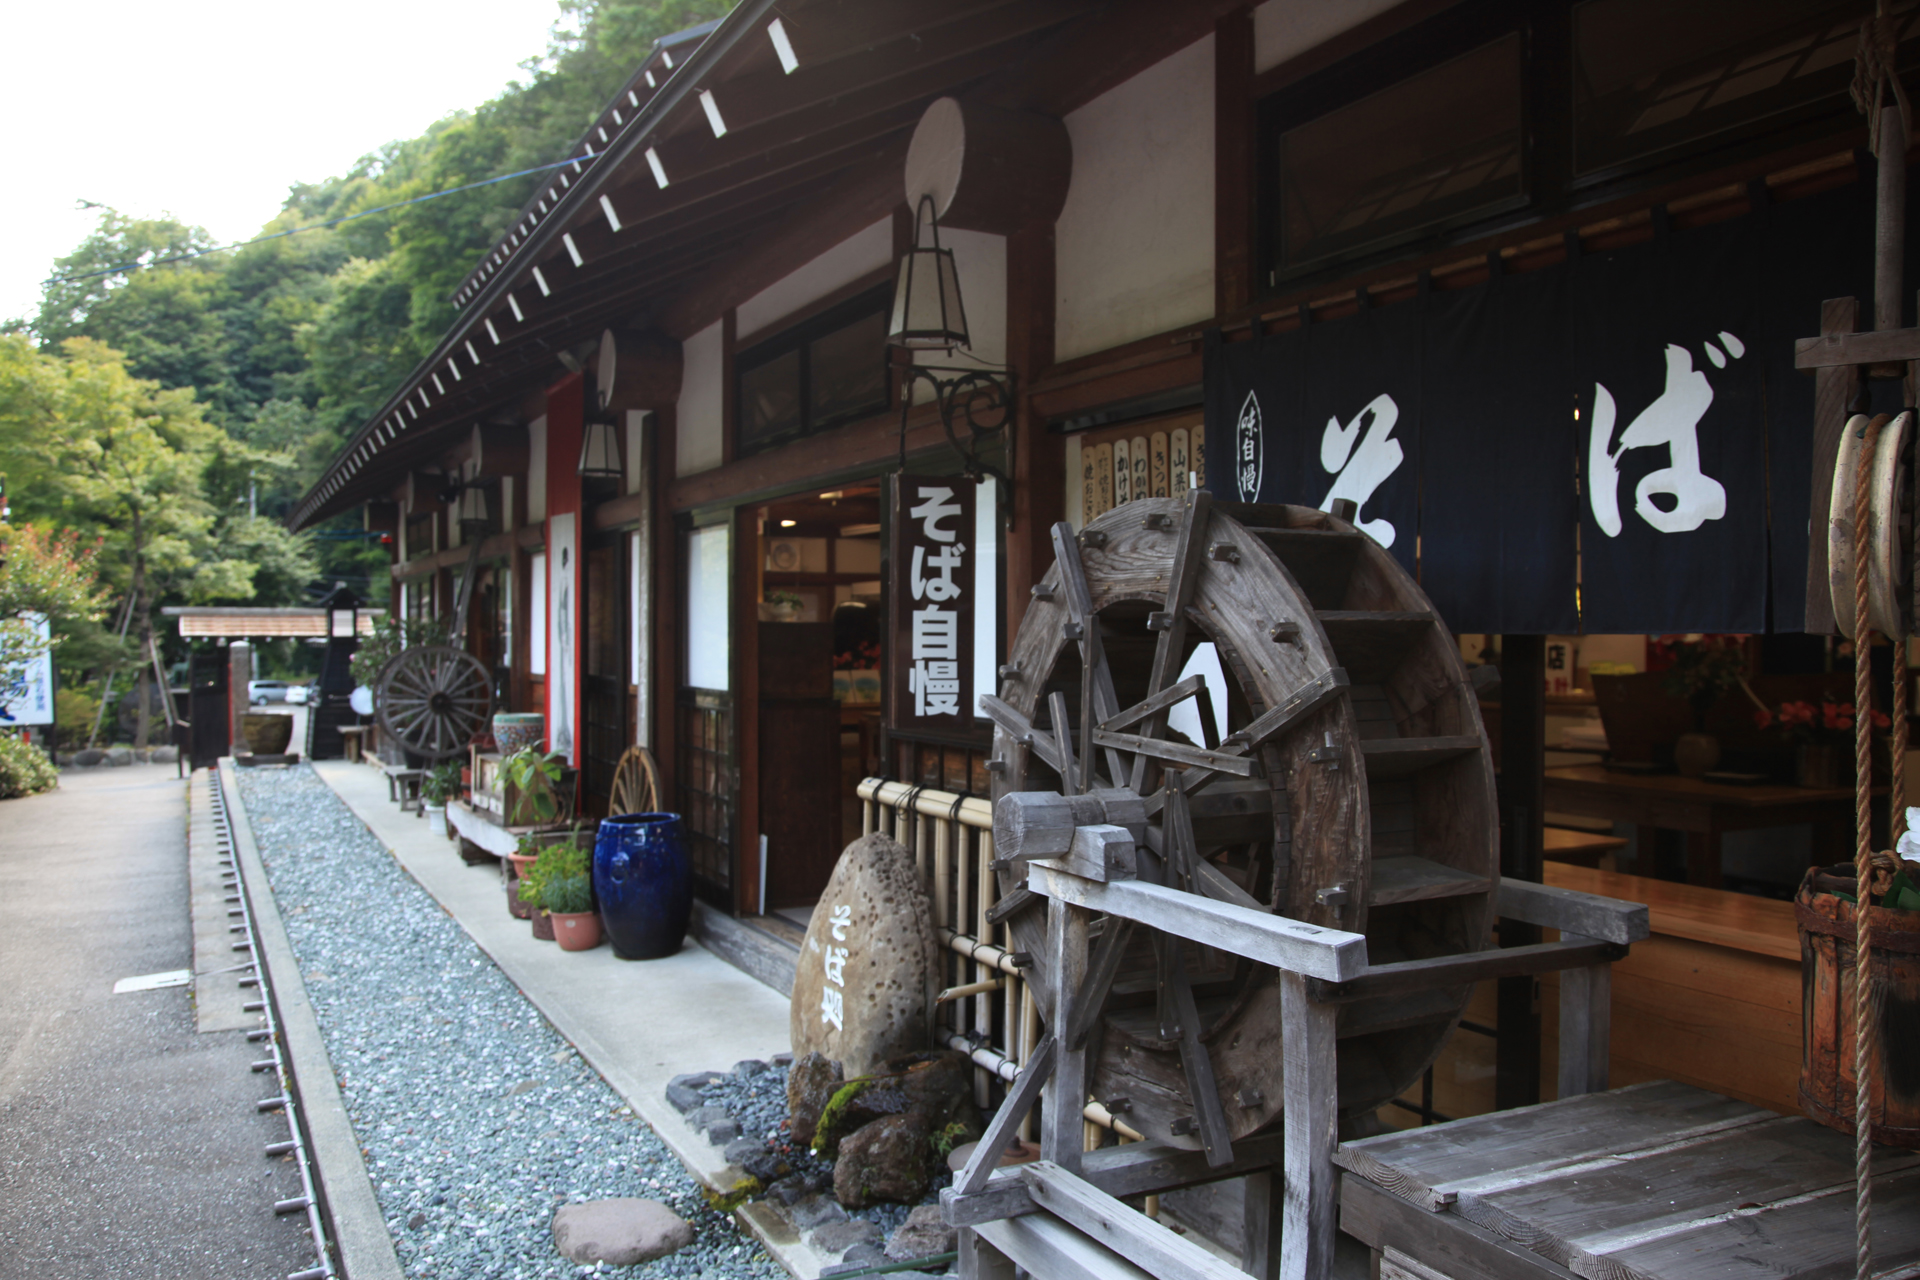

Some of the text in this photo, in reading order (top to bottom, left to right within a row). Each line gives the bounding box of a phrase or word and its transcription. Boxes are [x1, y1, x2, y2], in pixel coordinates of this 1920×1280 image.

[1173, 449, 1186, 499] 山菜
[1240, 408, 1259, 494] 味自慢
[908, 486, 967, 717] そば自慢
